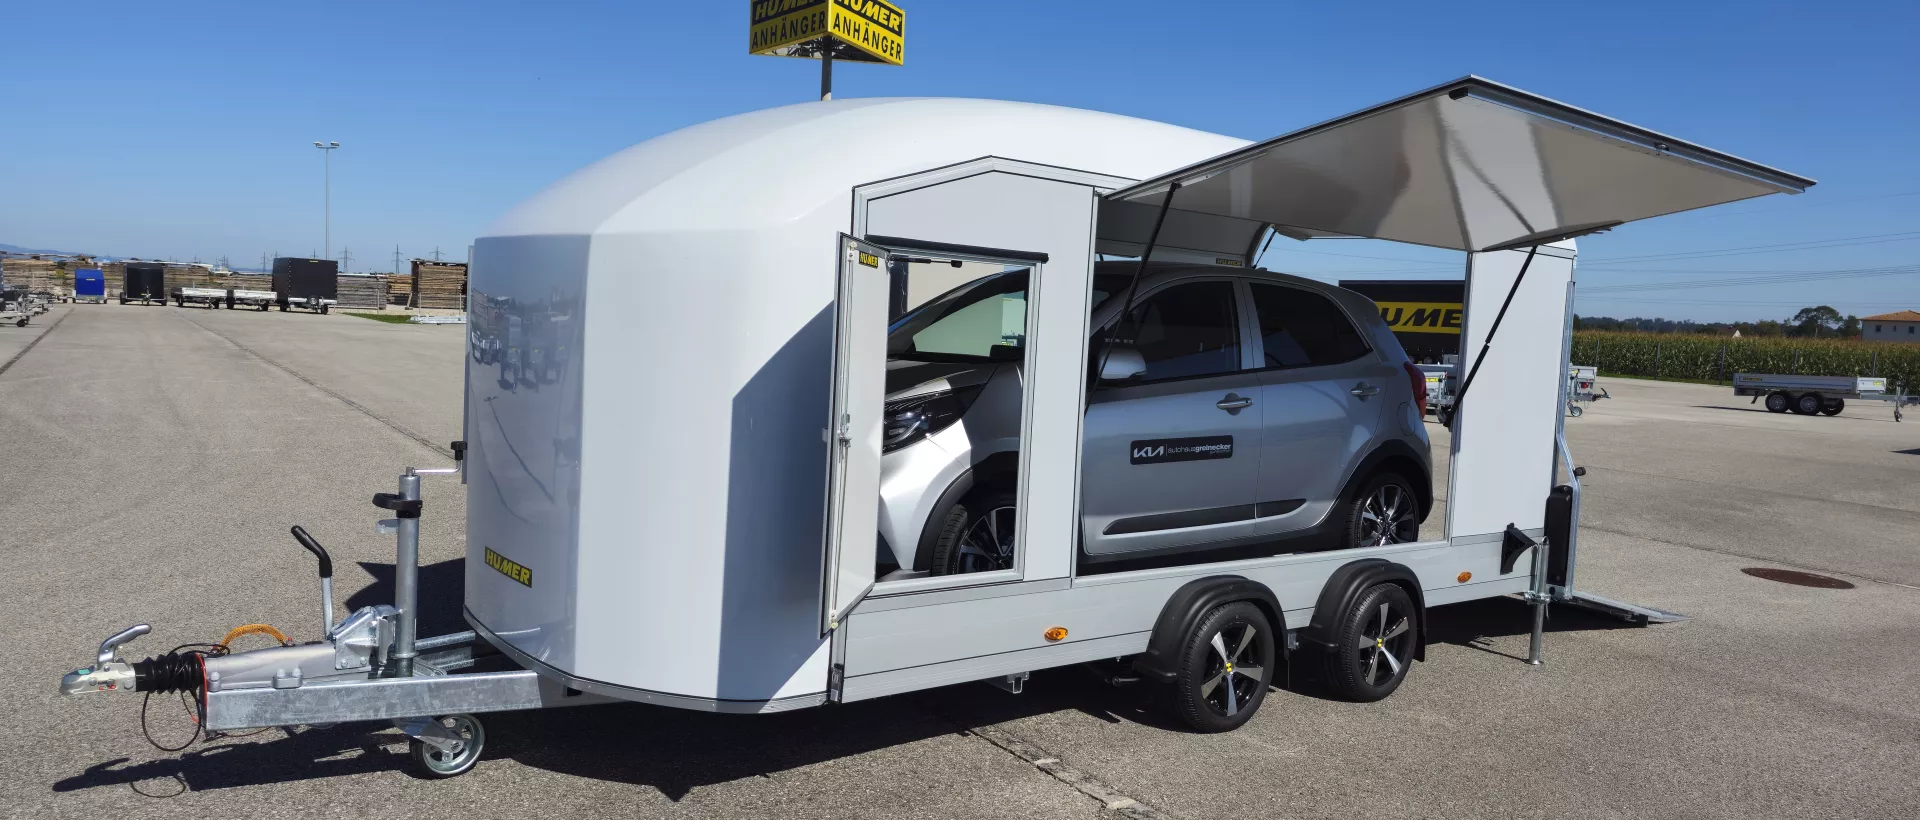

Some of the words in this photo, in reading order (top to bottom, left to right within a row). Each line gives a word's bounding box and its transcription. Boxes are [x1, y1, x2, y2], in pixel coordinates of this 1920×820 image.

[755, 0, 815, 20] HUM
[752, 10, 826, 49] ANHÄNGER
[833, 12, 902, 61] ANHÄNGER
[860, 252, 878, 267] HUMER
[1380, 307, 1462, 327] UME
[486, 549, 530, 585] HUMER
